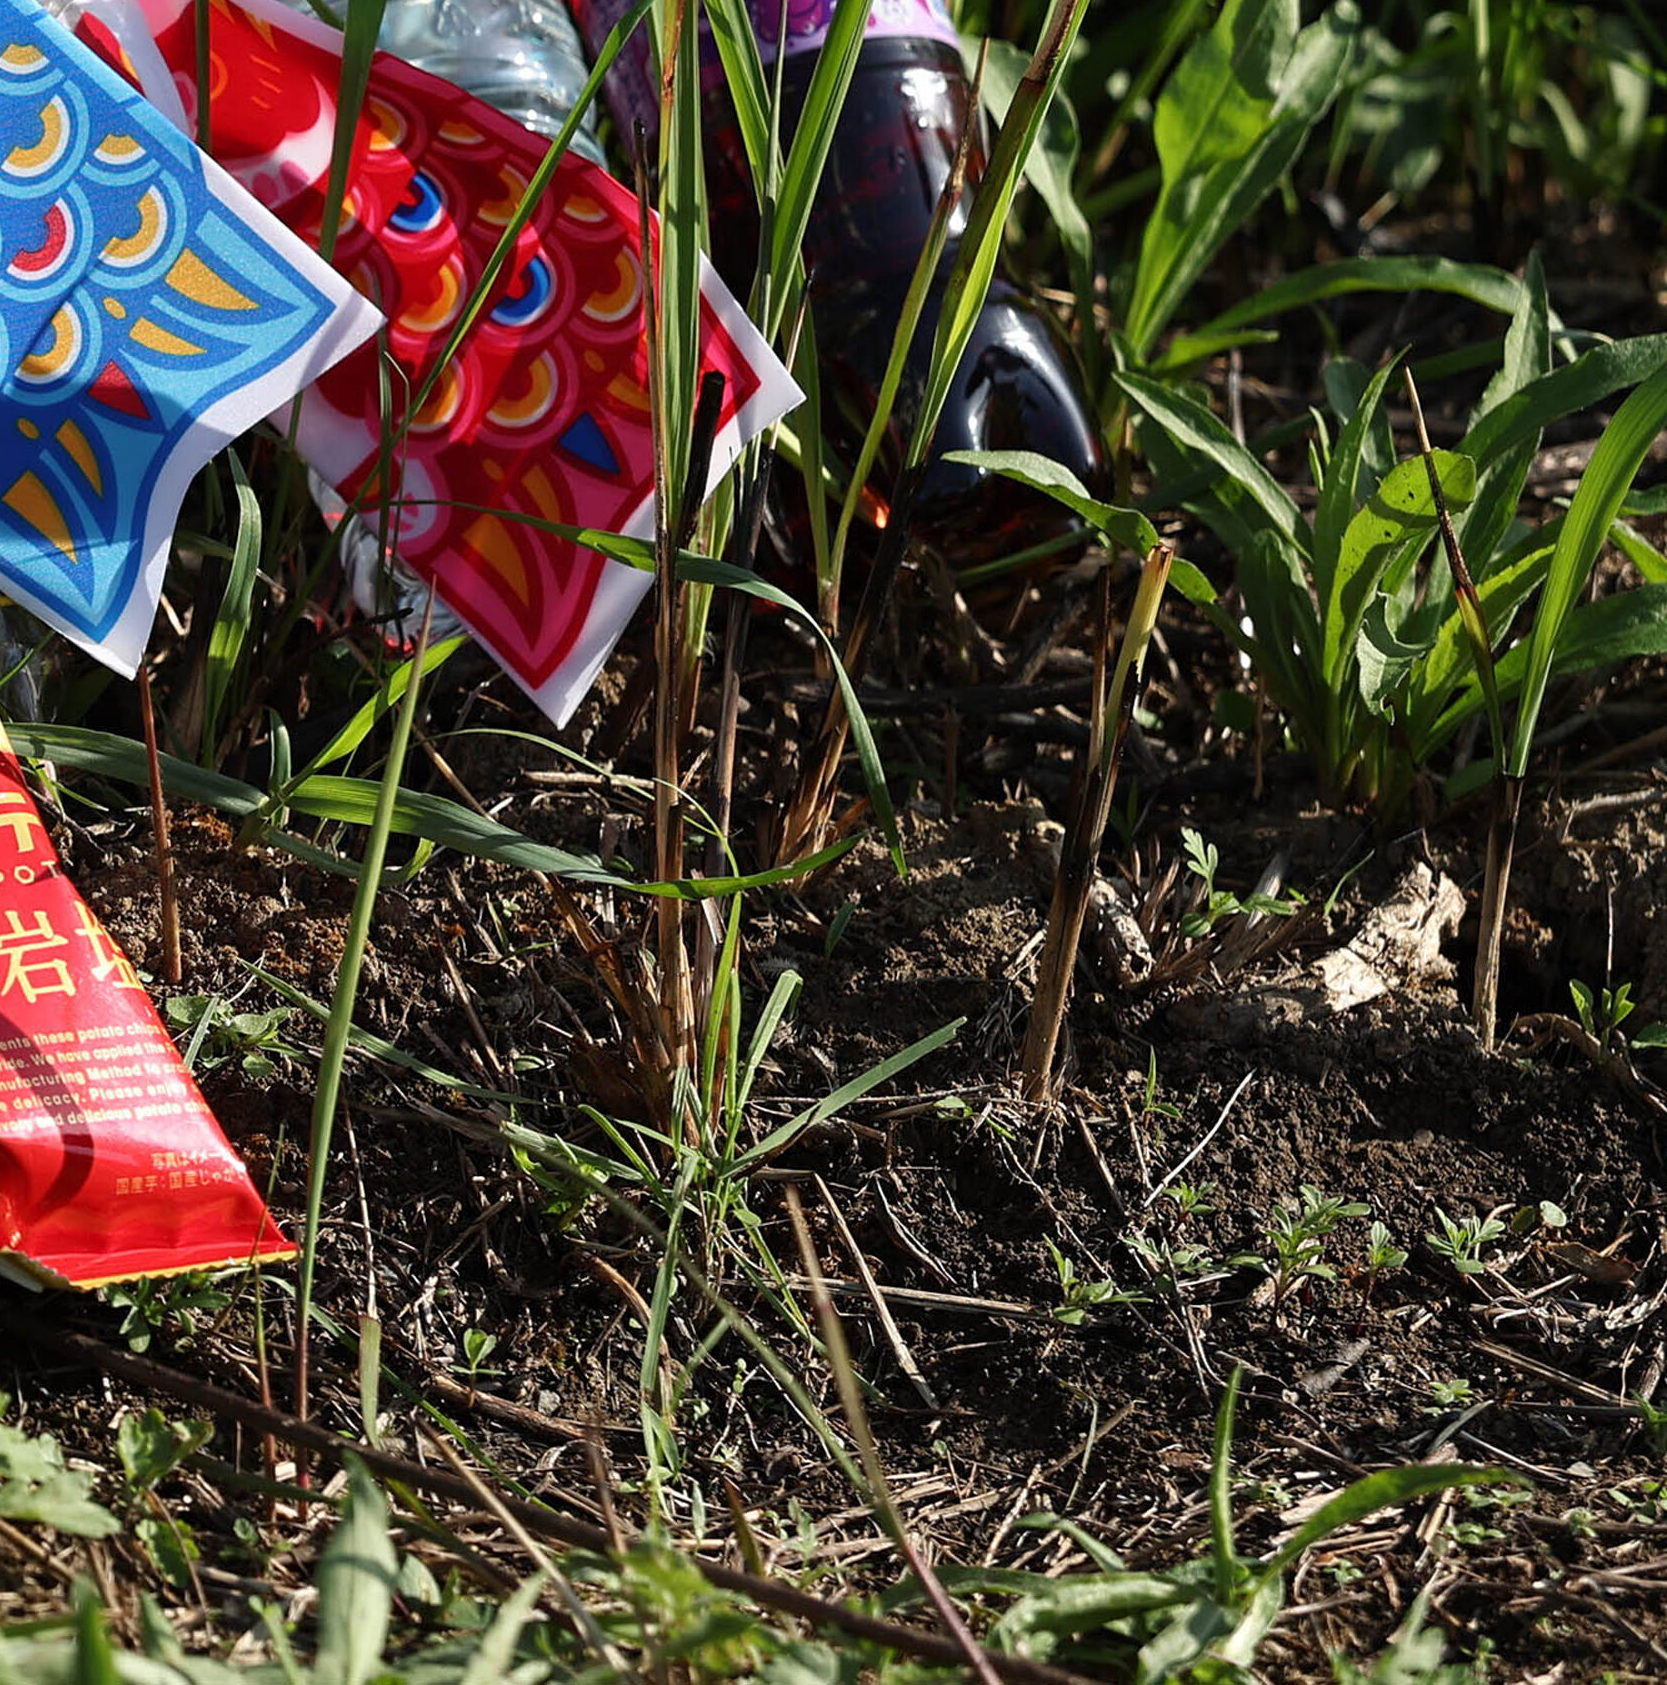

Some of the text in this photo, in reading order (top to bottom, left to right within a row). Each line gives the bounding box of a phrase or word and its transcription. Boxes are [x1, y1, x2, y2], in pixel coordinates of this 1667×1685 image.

[33, 1030, 74, 1047] these
[77, 1023, 124, 1044] potato
[31, 1049, 55, 1068] We
[57, 1046, 90, 1066] have
[93, 1040, 142, 1062] applied
[144, 1038, 166, 1056] the
[89, 1064, 142, 1084] Method
[144, 1062, 161, 1077] to
[13, 1089, 87, 1112] delicacy.
[90, 1082, 144, 1101] Please
[67, 1106, 132, 1126] delicious
[134, 1102, 181, 1122] potato
